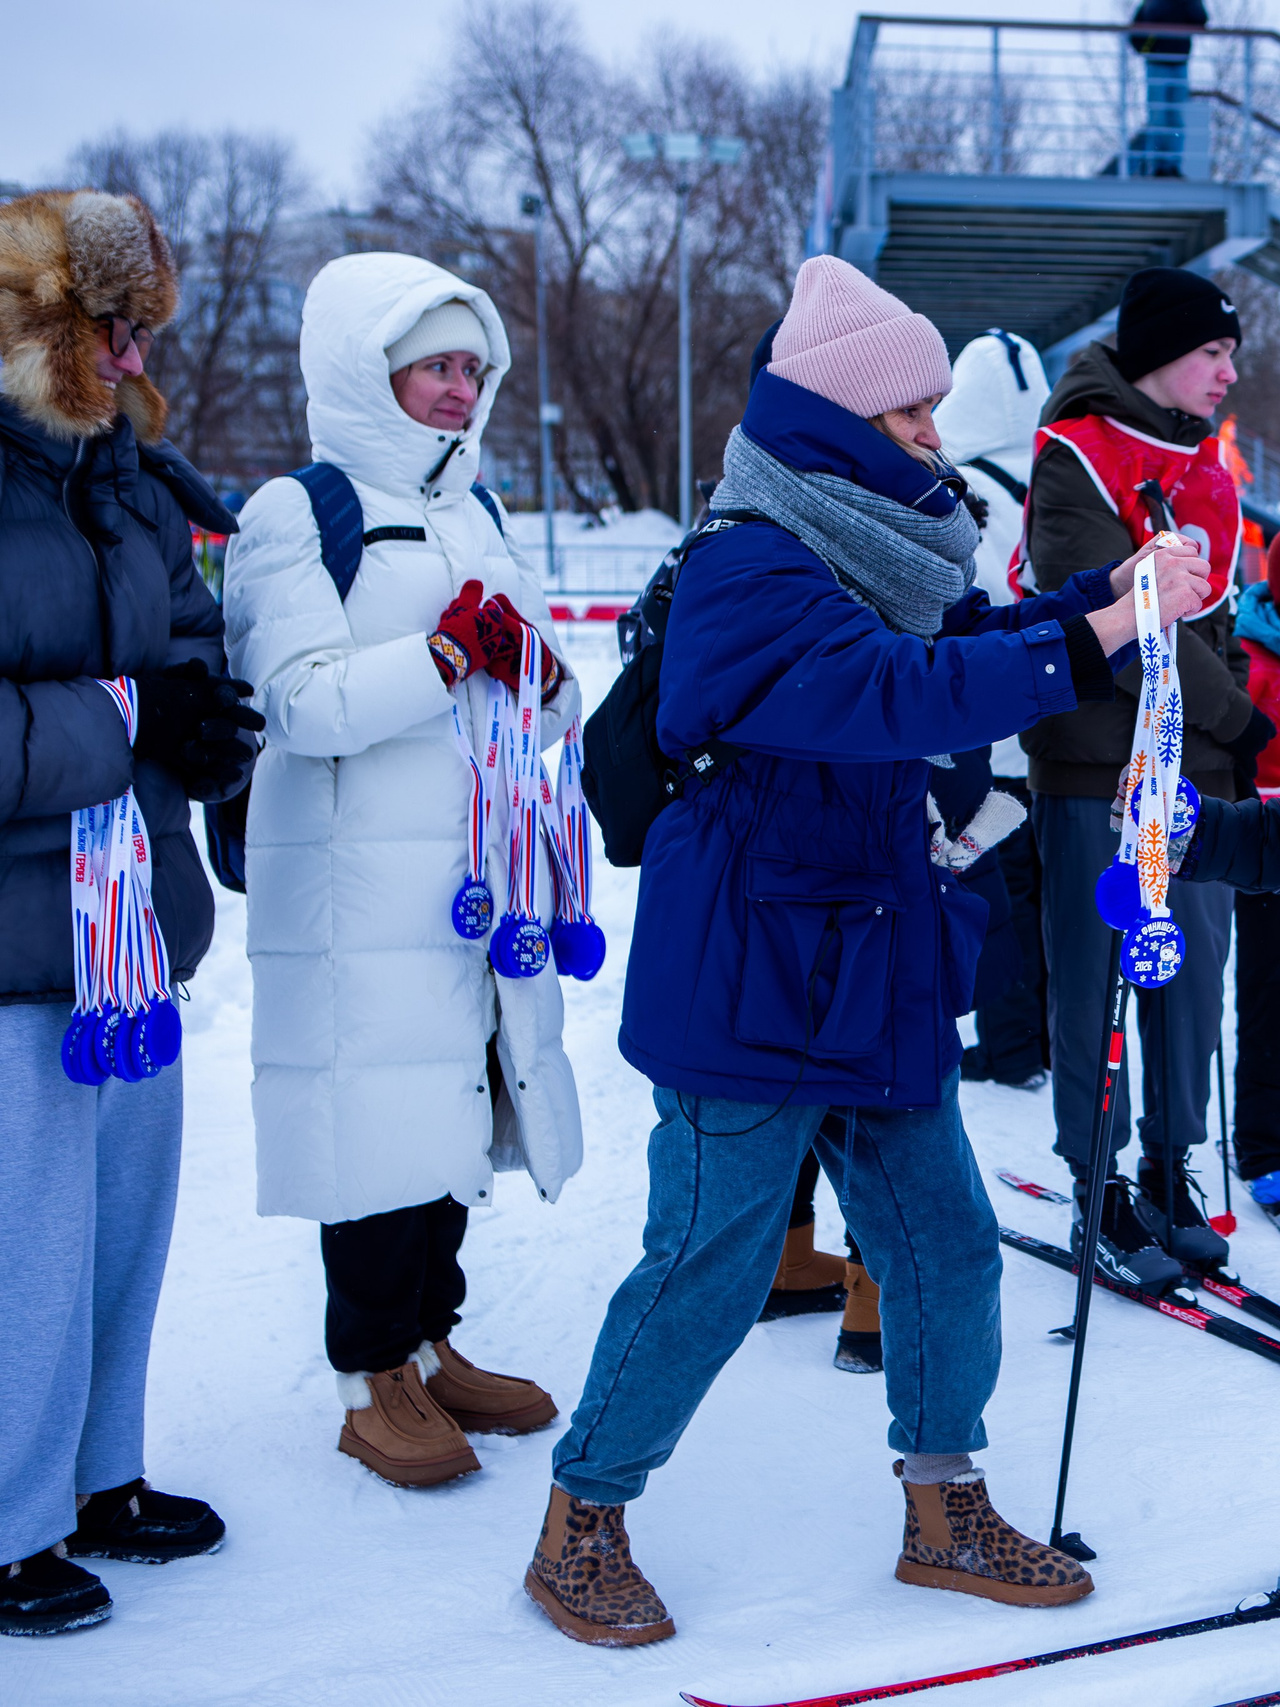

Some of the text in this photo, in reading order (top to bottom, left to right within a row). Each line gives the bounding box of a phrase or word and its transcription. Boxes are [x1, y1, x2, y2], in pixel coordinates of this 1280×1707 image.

[75, 853, 86, 882] ГЕРОЕВ
[1134, 961, 1153, 972] 2026
[1096, 1241, 1142, 1285] PINE
[1159, 1301, 1207, 1331] CLASSIC
